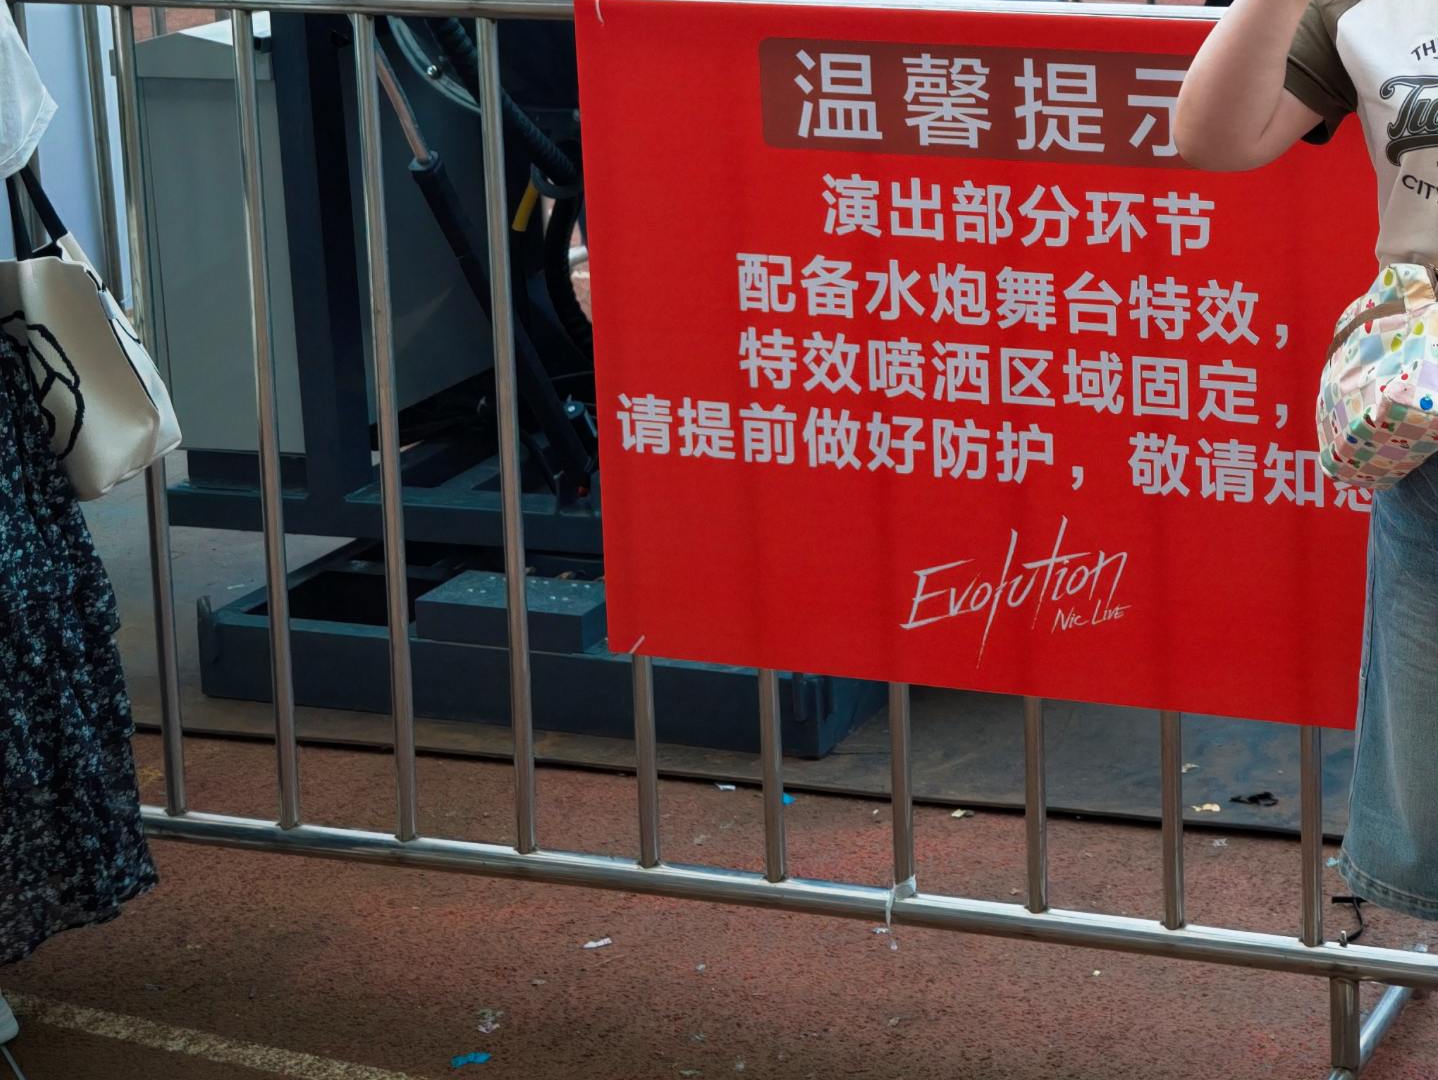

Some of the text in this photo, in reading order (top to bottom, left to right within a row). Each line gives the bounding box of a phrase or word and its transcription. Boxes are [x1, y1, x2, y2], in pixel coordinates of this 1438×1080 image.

[794, 50, 1187, 157] 温馨提示
[822, 174, 1215, 256] 演出部分环节
[736, 253, 1289, 350] 配备水炮舞台特效，
[739, 327, 1288, 430] 特效喷洒区域固定，
[899, 515, 1129, 670] Evolution
